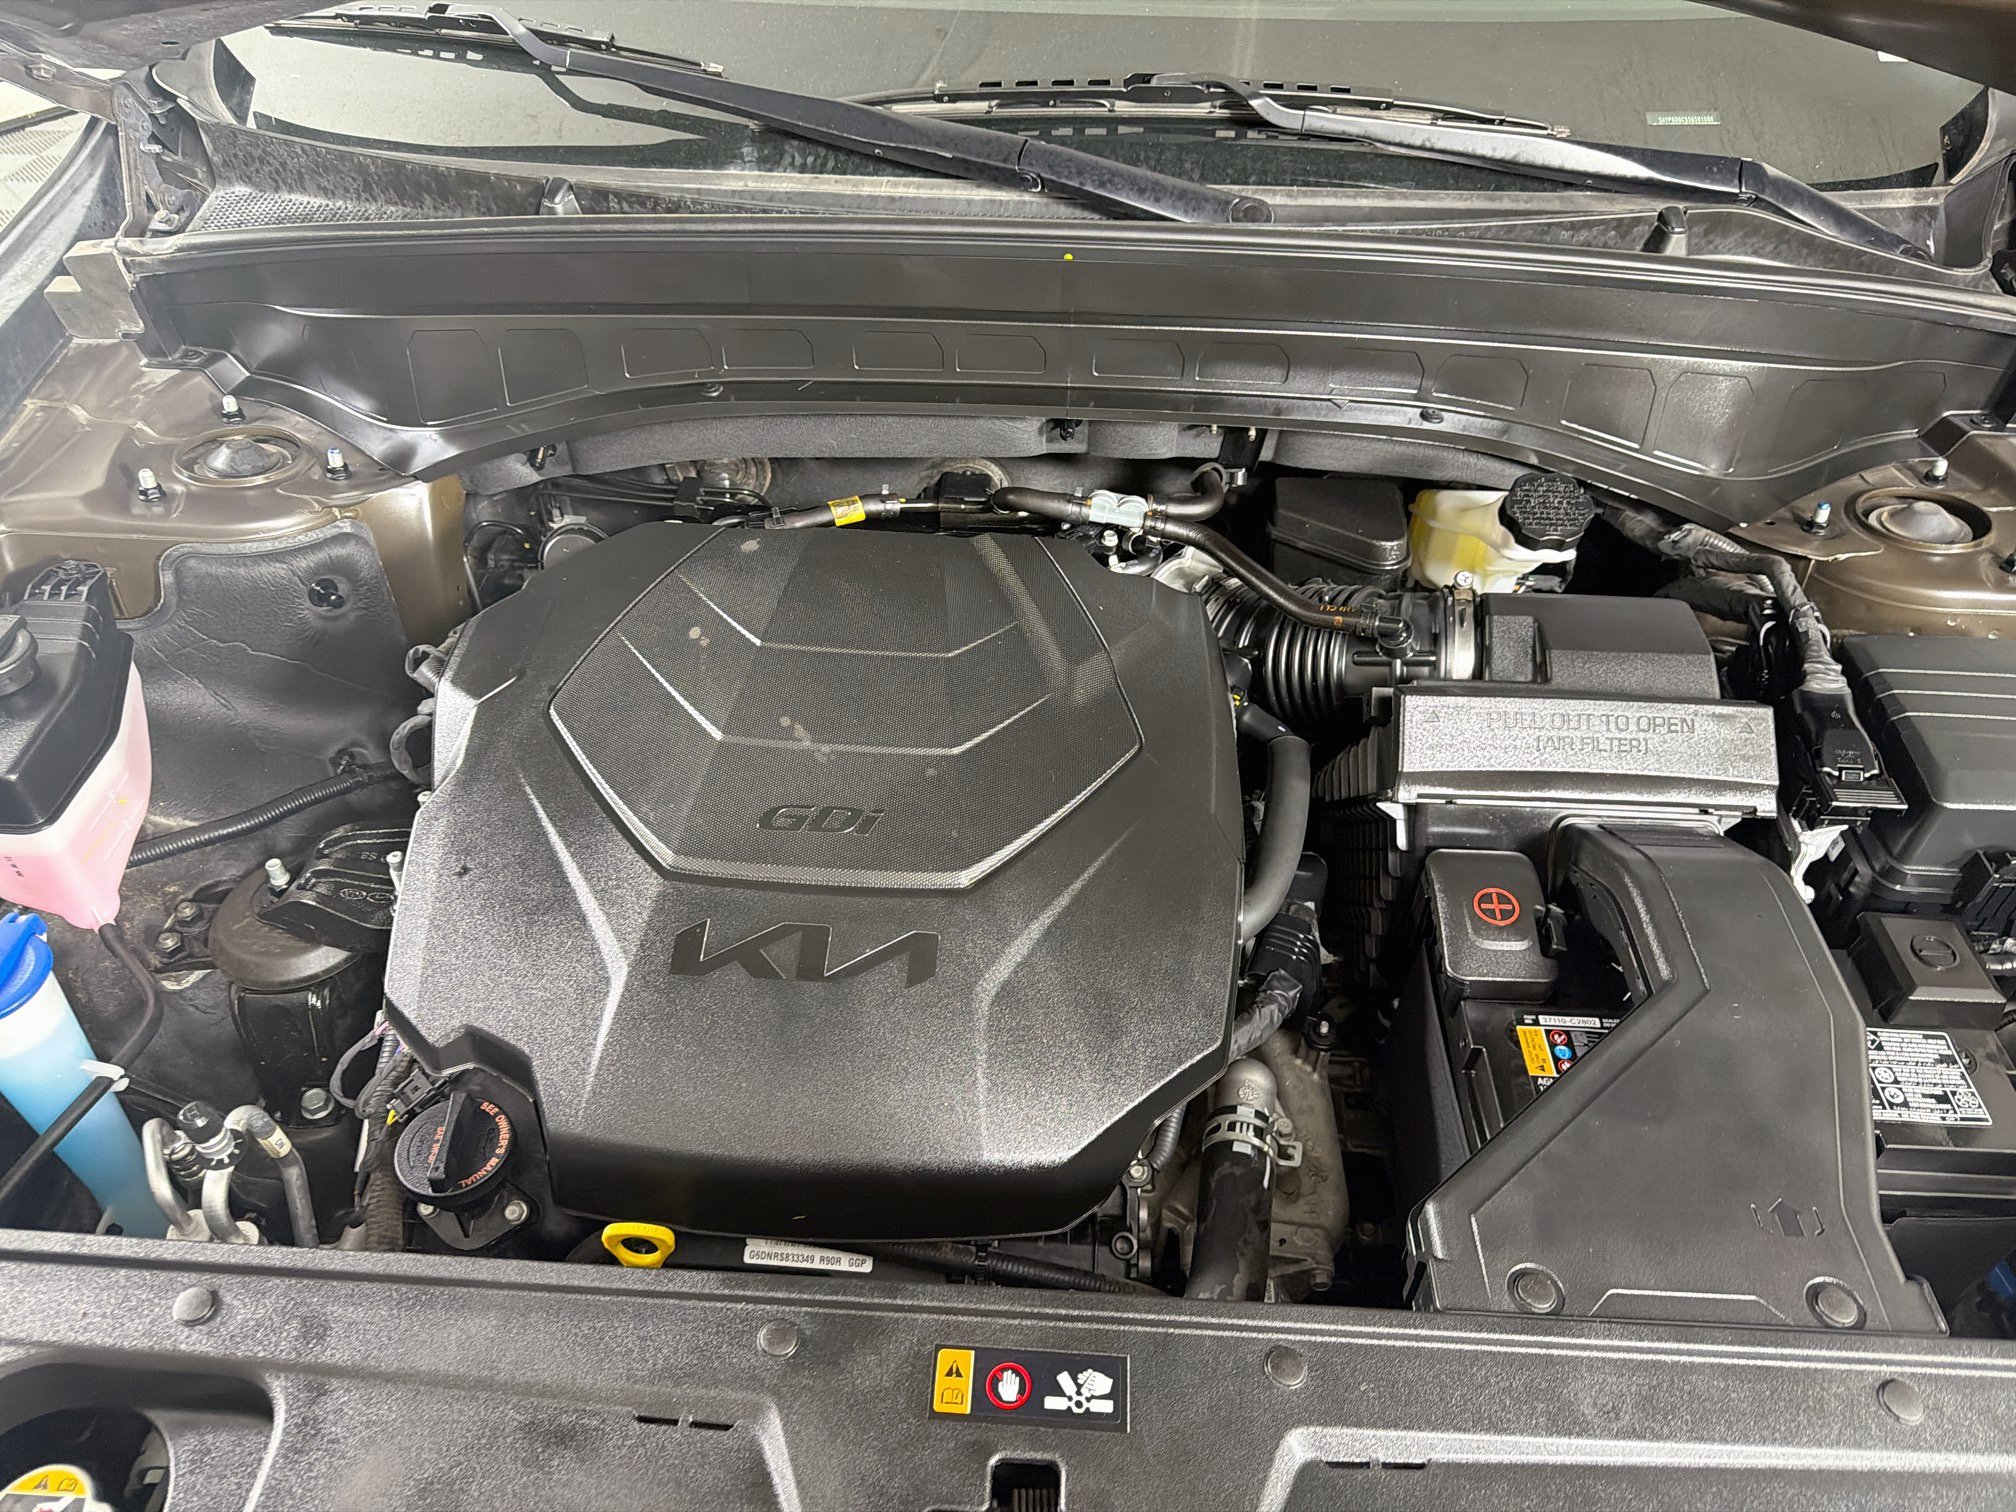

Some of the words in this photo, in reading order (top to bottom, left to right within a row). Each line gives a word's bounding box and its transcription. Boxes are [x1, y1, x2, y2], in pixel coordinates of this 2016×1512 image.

[1486, 710, 1544, 729] PULL
[1550, 713, 1594, 731] OUT
[1601, 714, 1630, 732] TO
[1636, 715, 1695, 734] OPEN
[480, 1101, 500, 1116] SEE
[494, 1114, 512, 1155] OWNER'S
[457, 1156, 500, 1188] MANUAL
[848, 1257, 867, 1268] GGP
